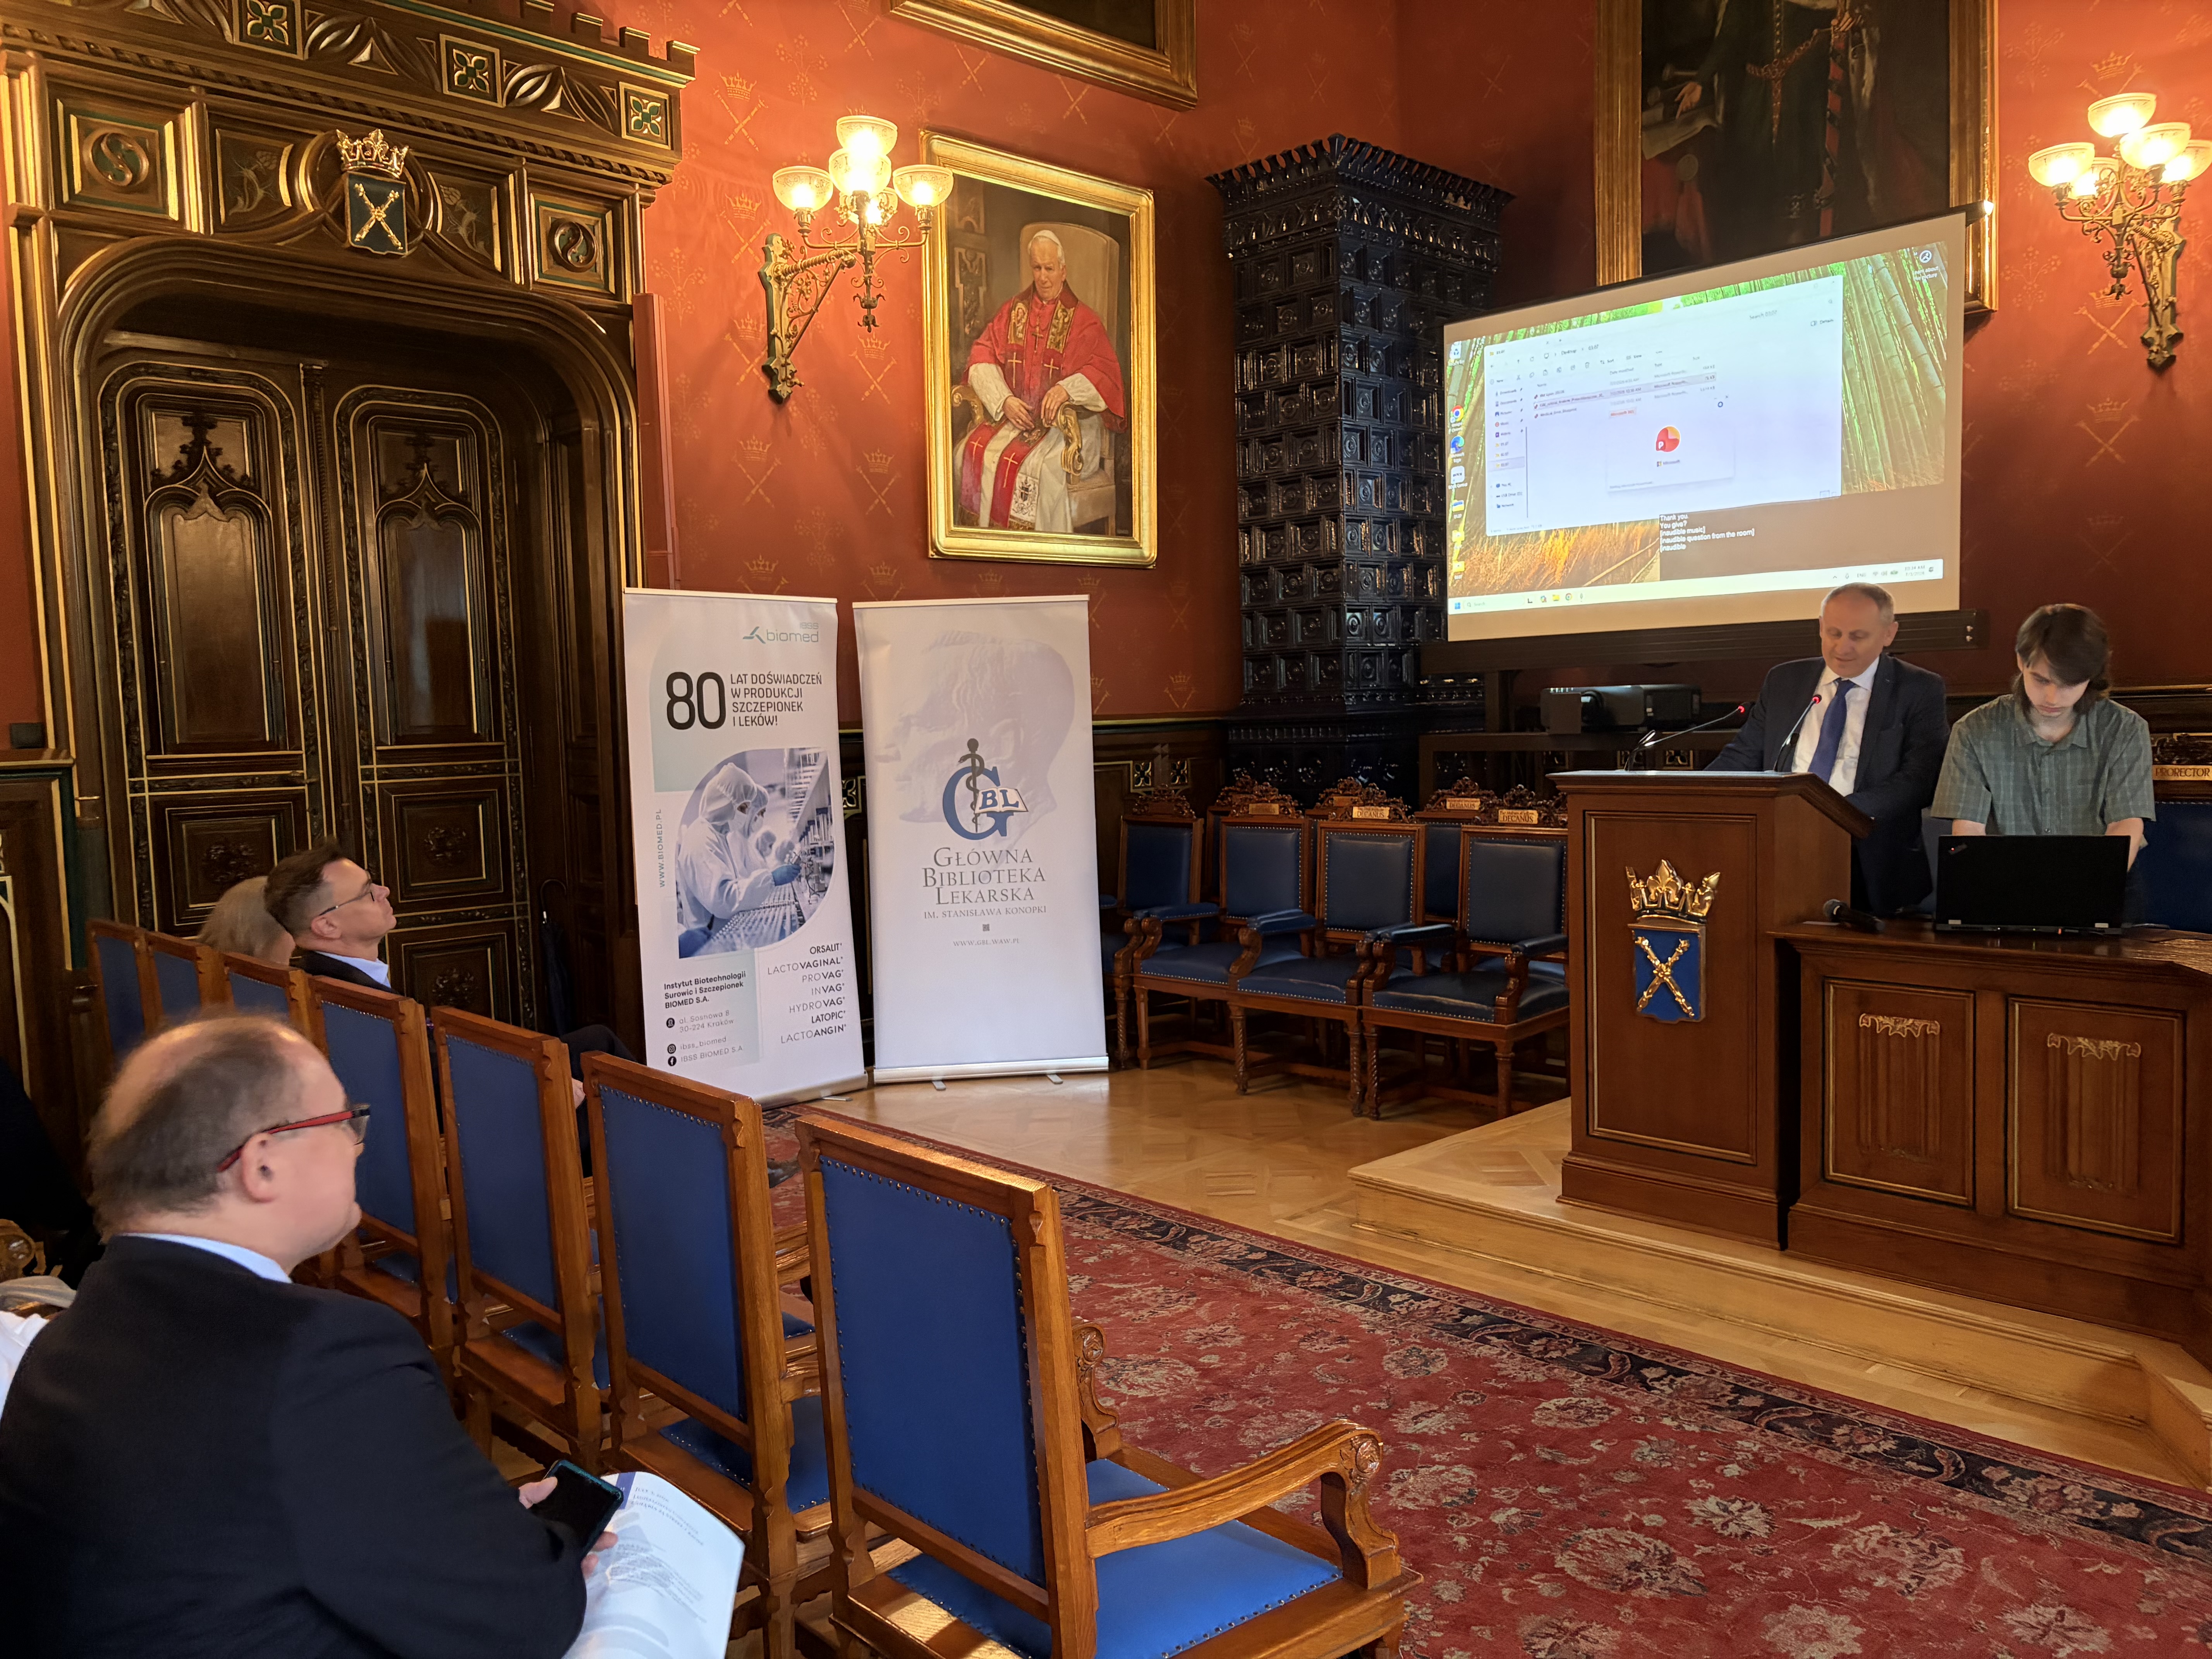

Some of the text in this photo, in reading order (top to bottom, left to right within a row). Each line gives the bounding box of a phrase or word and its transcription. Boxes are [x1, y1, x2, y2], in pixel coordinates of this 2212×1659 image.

[1671, 520, 1688, 529] give?
[1686, 533, 1711, 543] question
[766, 629, 819, 642] biomed
[730, 671, 822, 685] LAT DOŚWIADCZEŃ
[731, 688, 802, 698] W PRODUKCJI
[666, 672, 726, 730] 80
[732, 701, 803, 713] SZCZEPIONEK
[733, 713, 778, 726] I LEKÓW!
[2155, 768, 2210, 777] PRORECTOR
[656, 809, 665, 888] WWW.BIOMED.PL
[934, 847, 1034, 867] GŁÓWNA
[922, 867, 1046, 887] BIBLIOTEKA
[936, 887, 1035, 905] LEKARSKA
[942, 908, 1002, 918] STANISŁAWA
[1005, 906, 1046, 915] KONOPKI
[664, 970, 746, 990] Instytut Biotechnologii
[665, 989, 693, 999] Surowic
[699, 981, 744, 994] Szczepionek
[665, 998, 694, 1009] BIOMED
[681, 1053, 697, 1062] IBSS
[700, 1048, 730, 1059] BIOMED
